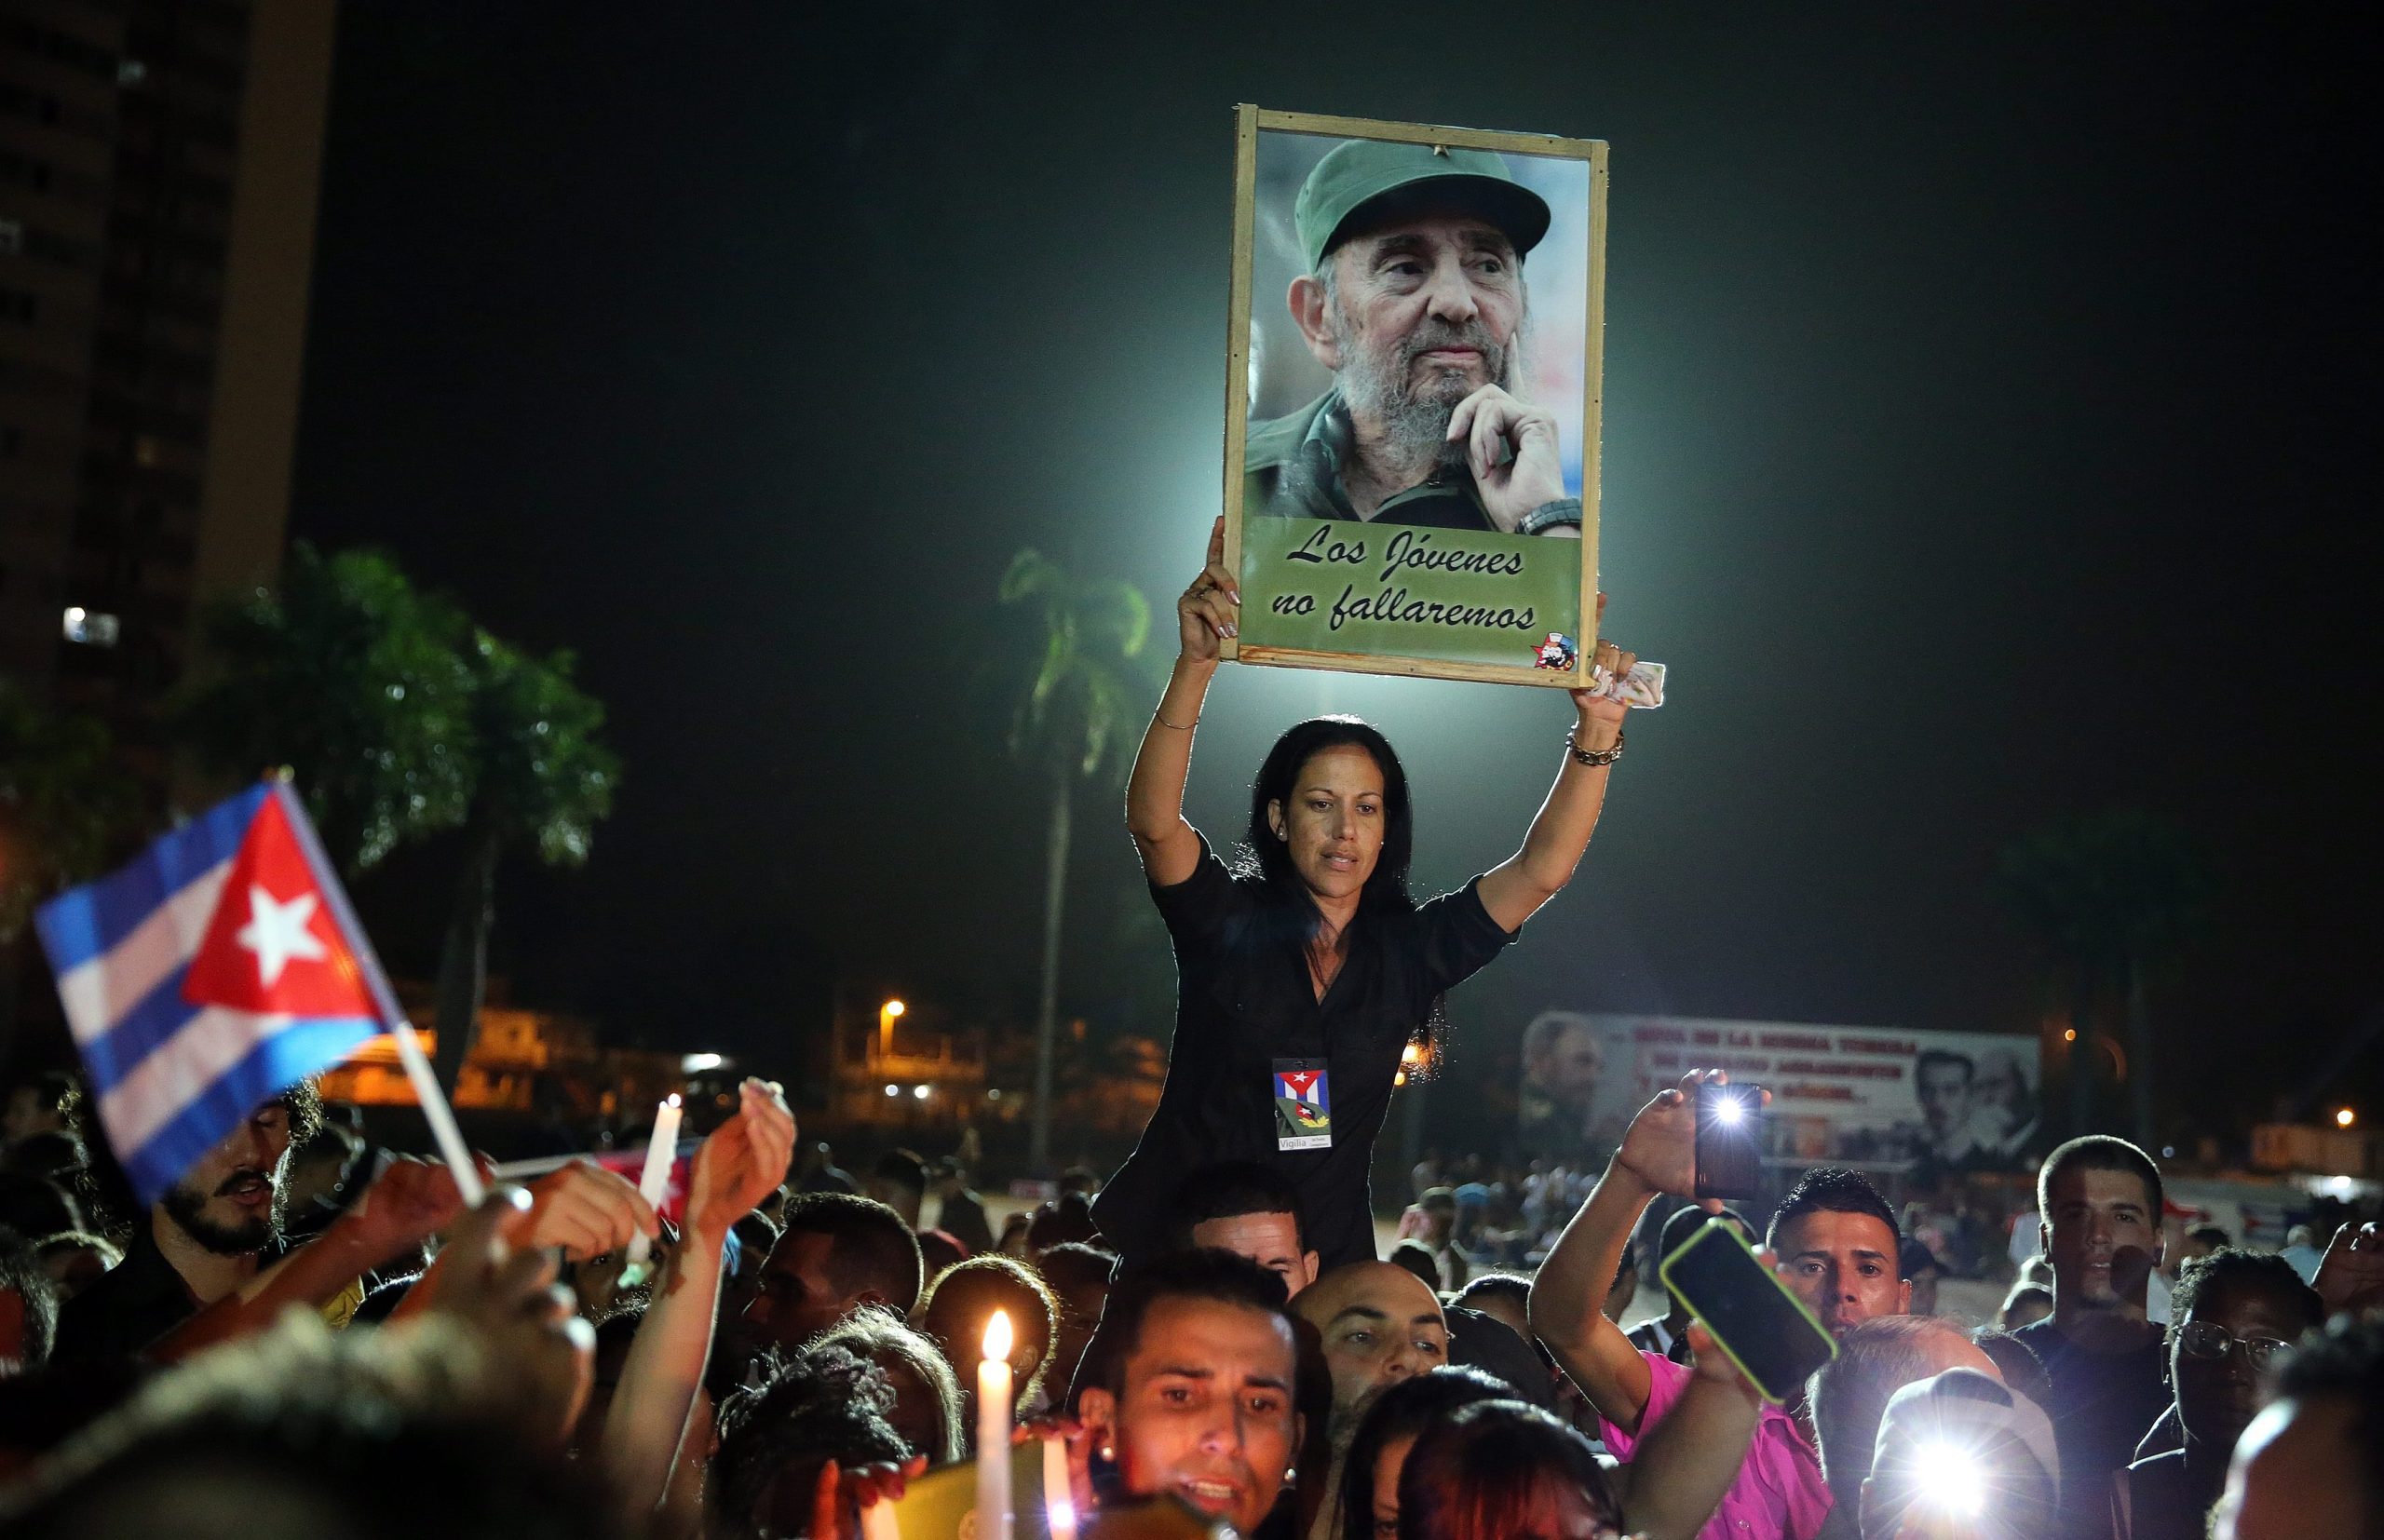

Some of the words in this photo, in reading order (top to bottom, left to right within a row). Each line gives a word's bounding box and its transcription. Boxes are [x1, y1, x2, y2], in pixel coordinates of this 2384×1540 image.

[1286, 523, 1367, 564] Los
[1379, 530, 1524, 583] Jóvenes
[1272, 593, 1316, 615] no
[1330, 584, 1536, 631] fallaremos
[1280, 1139, 1307, 1149] Vigilia
